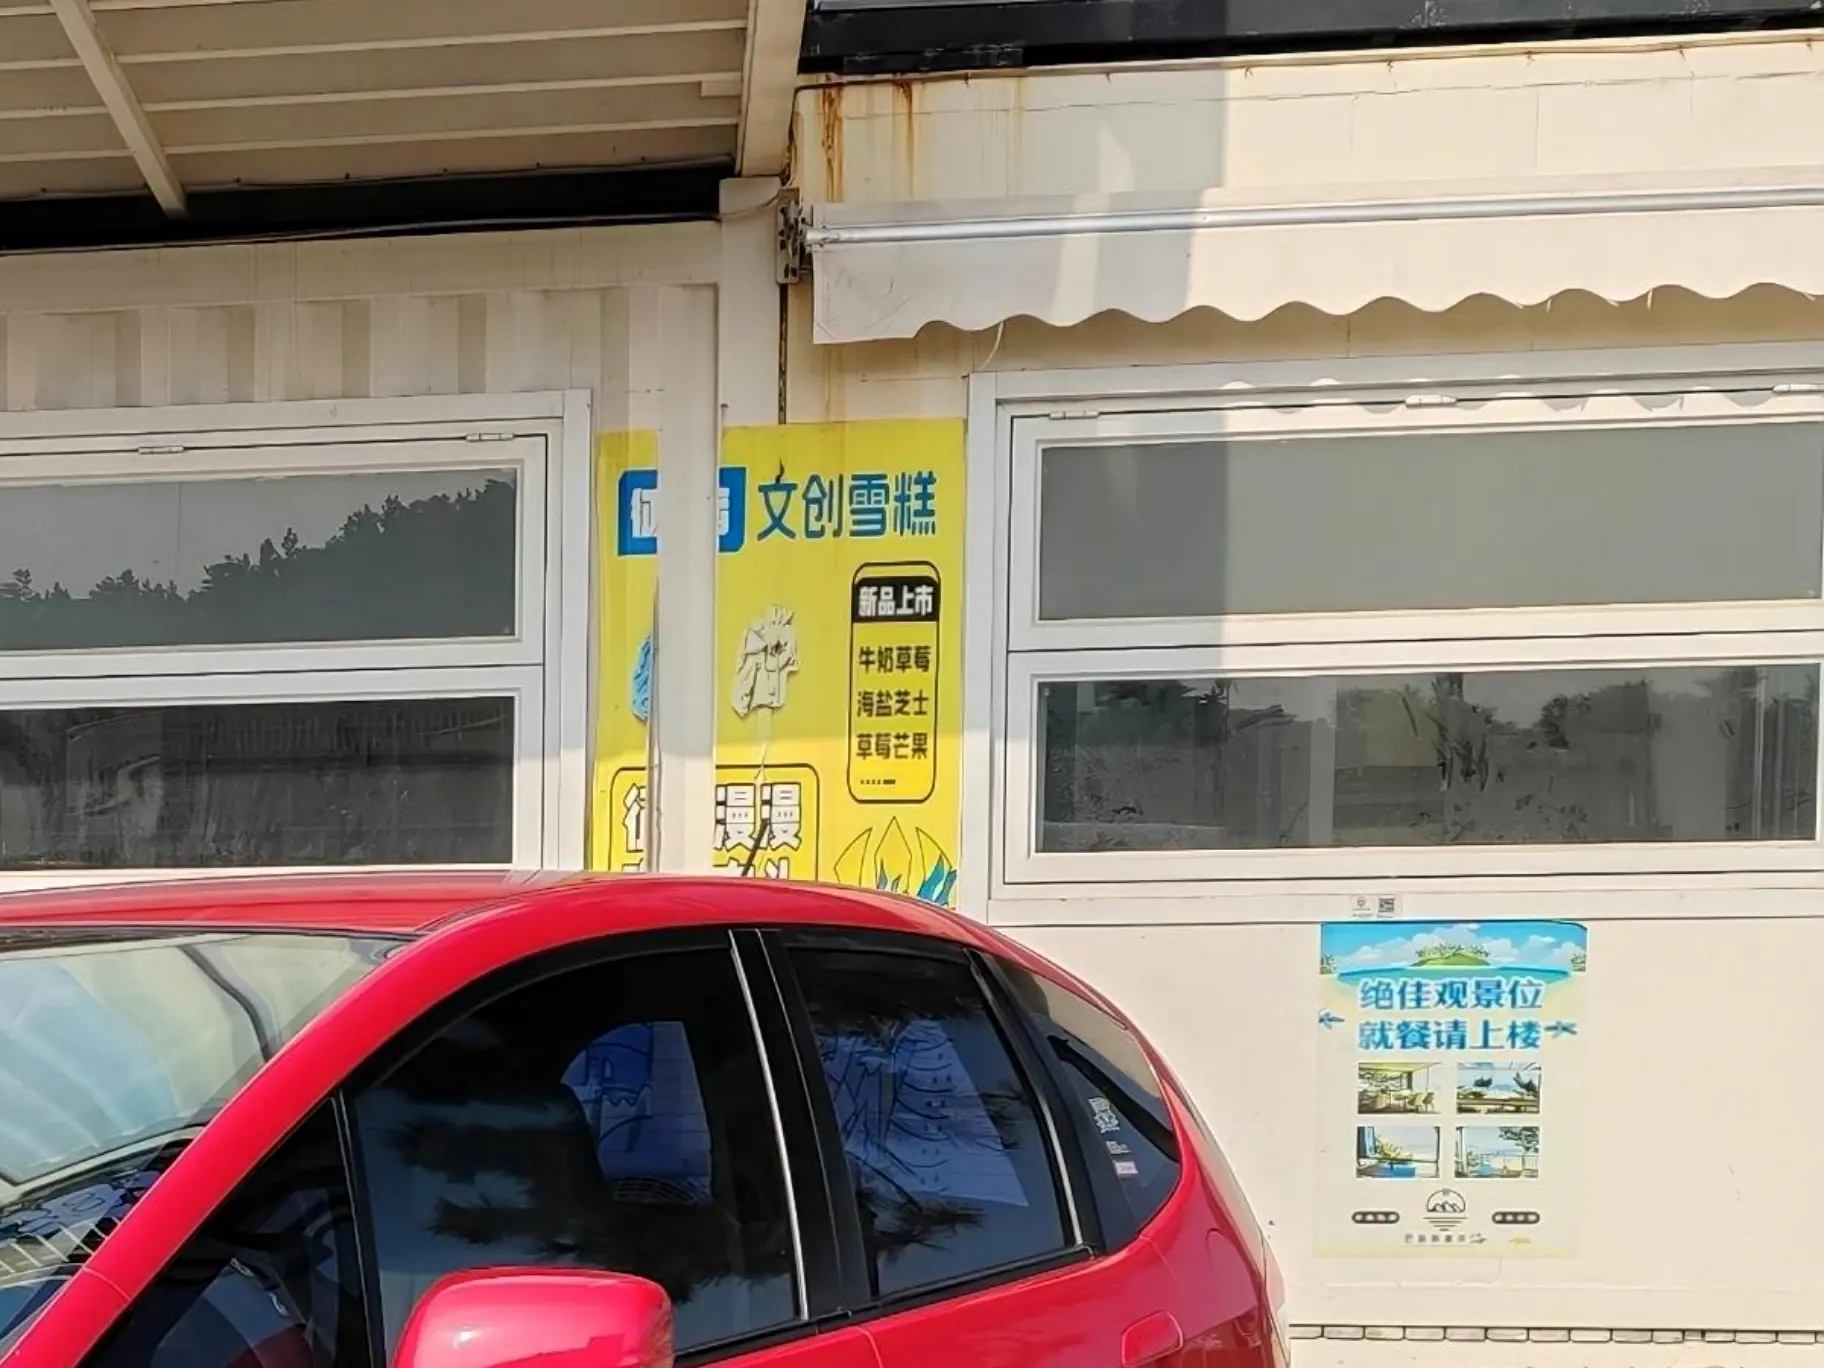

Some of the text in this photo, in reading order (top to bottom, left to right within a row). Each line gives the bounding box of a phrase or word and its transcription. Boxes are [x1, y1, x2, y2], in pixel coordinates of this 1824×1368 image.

[757, 470, 937, 542] 文创雪糕
[858, 584, 934, 617] 新品上市
[858, 645, 931, 674] 牛奶草莓
[856, 689, 929, 718] 海盐芝士
[856, 732, 928, 760] 草莓芒果
[1359, 978, 1543, 1010] 绝佳观景位
[1358, 1018, 1542, 1050] 就餐请上楼
